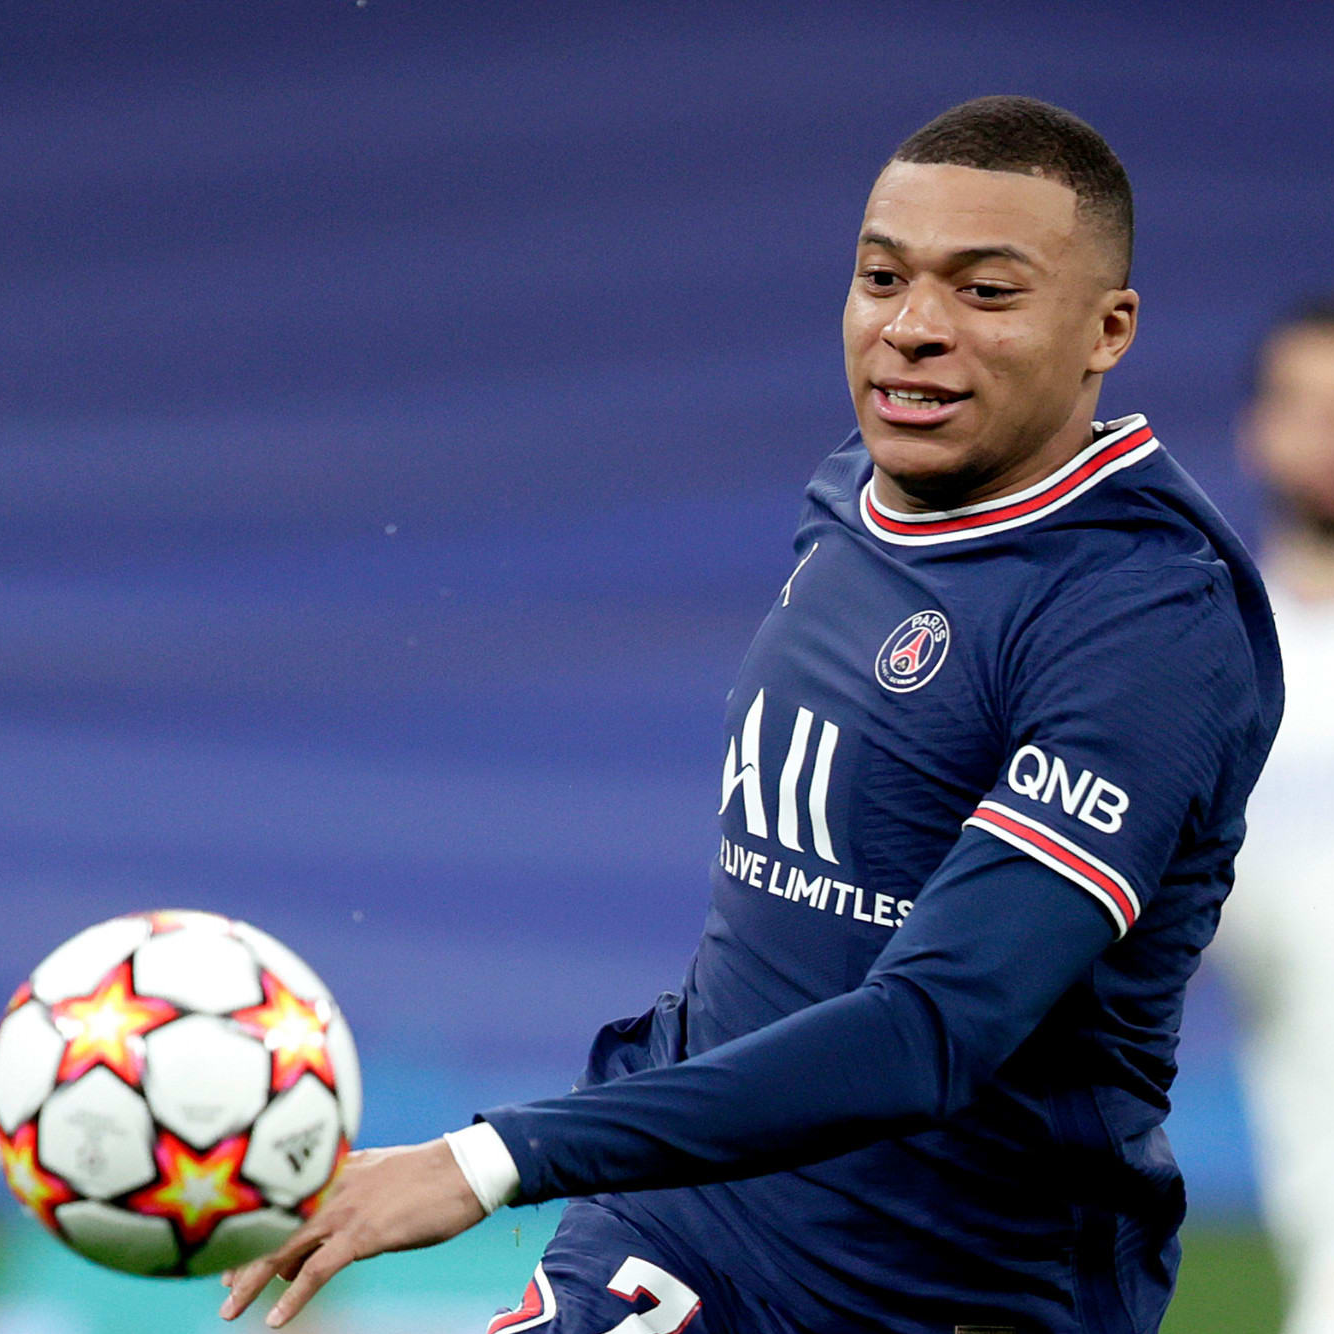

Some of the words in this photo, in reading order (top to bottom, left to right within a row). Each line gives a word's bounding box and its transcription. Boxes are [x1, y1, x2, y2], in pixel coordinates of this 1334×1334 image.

[911, 614, 946, 643] PARIS
[1007, 744, 1130, 834] QNB
[724, 838, 768, 889] LIVE
